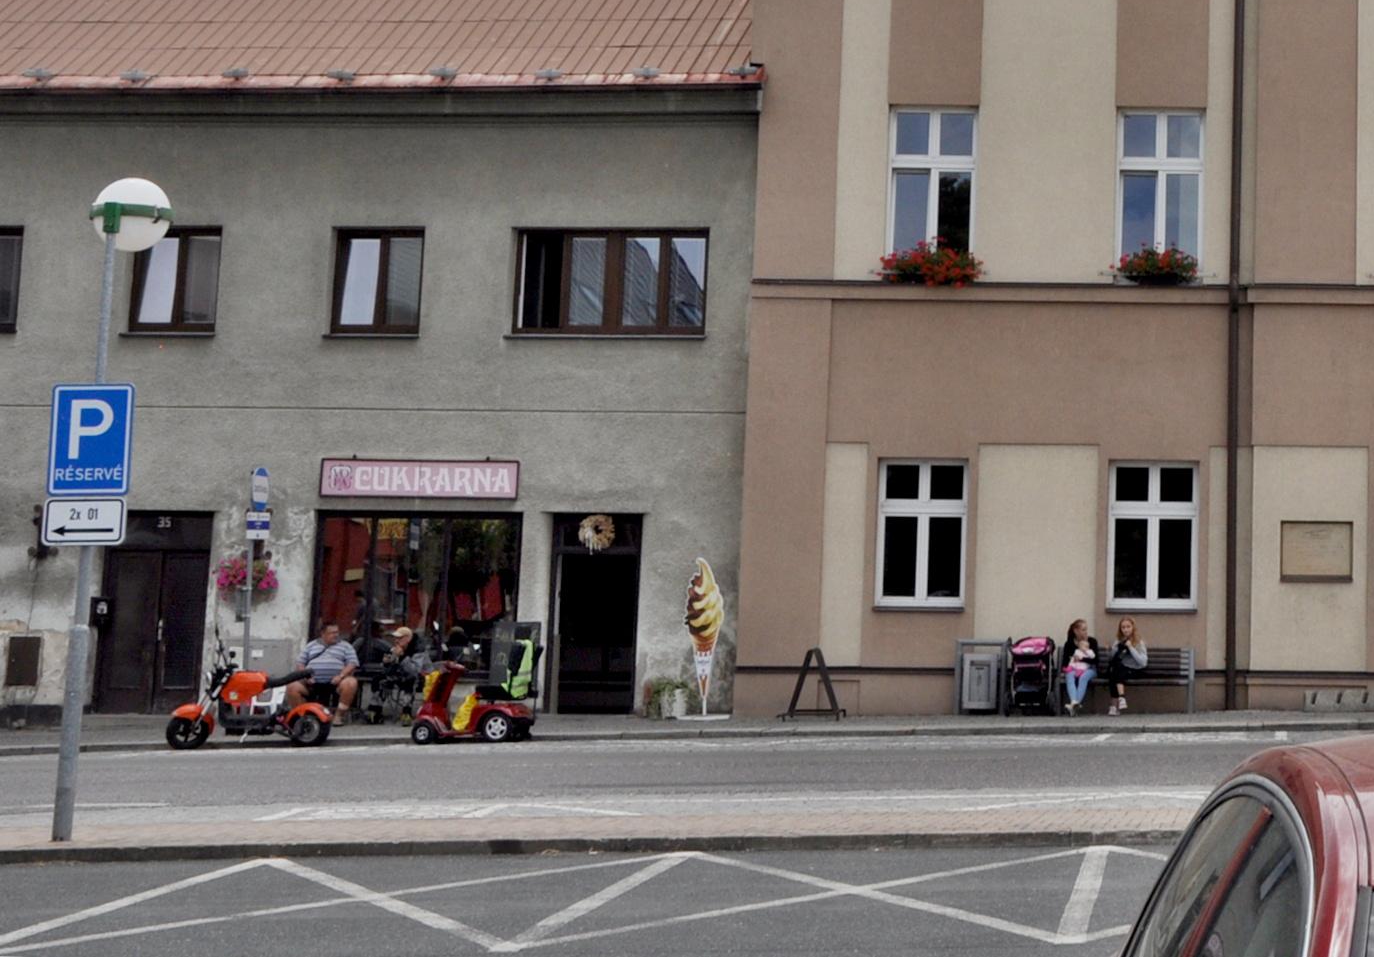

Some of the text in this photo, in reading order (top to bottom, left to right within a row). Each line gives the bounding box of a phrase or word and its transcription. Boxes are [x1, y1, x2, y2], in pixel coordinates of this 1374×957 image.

[68, 399, 114, 459] P
[55, 464, 123, 481] RÉSERVÉ
[69, 508, 81, 520] 2x
[157, 516, 172, 528] 35
